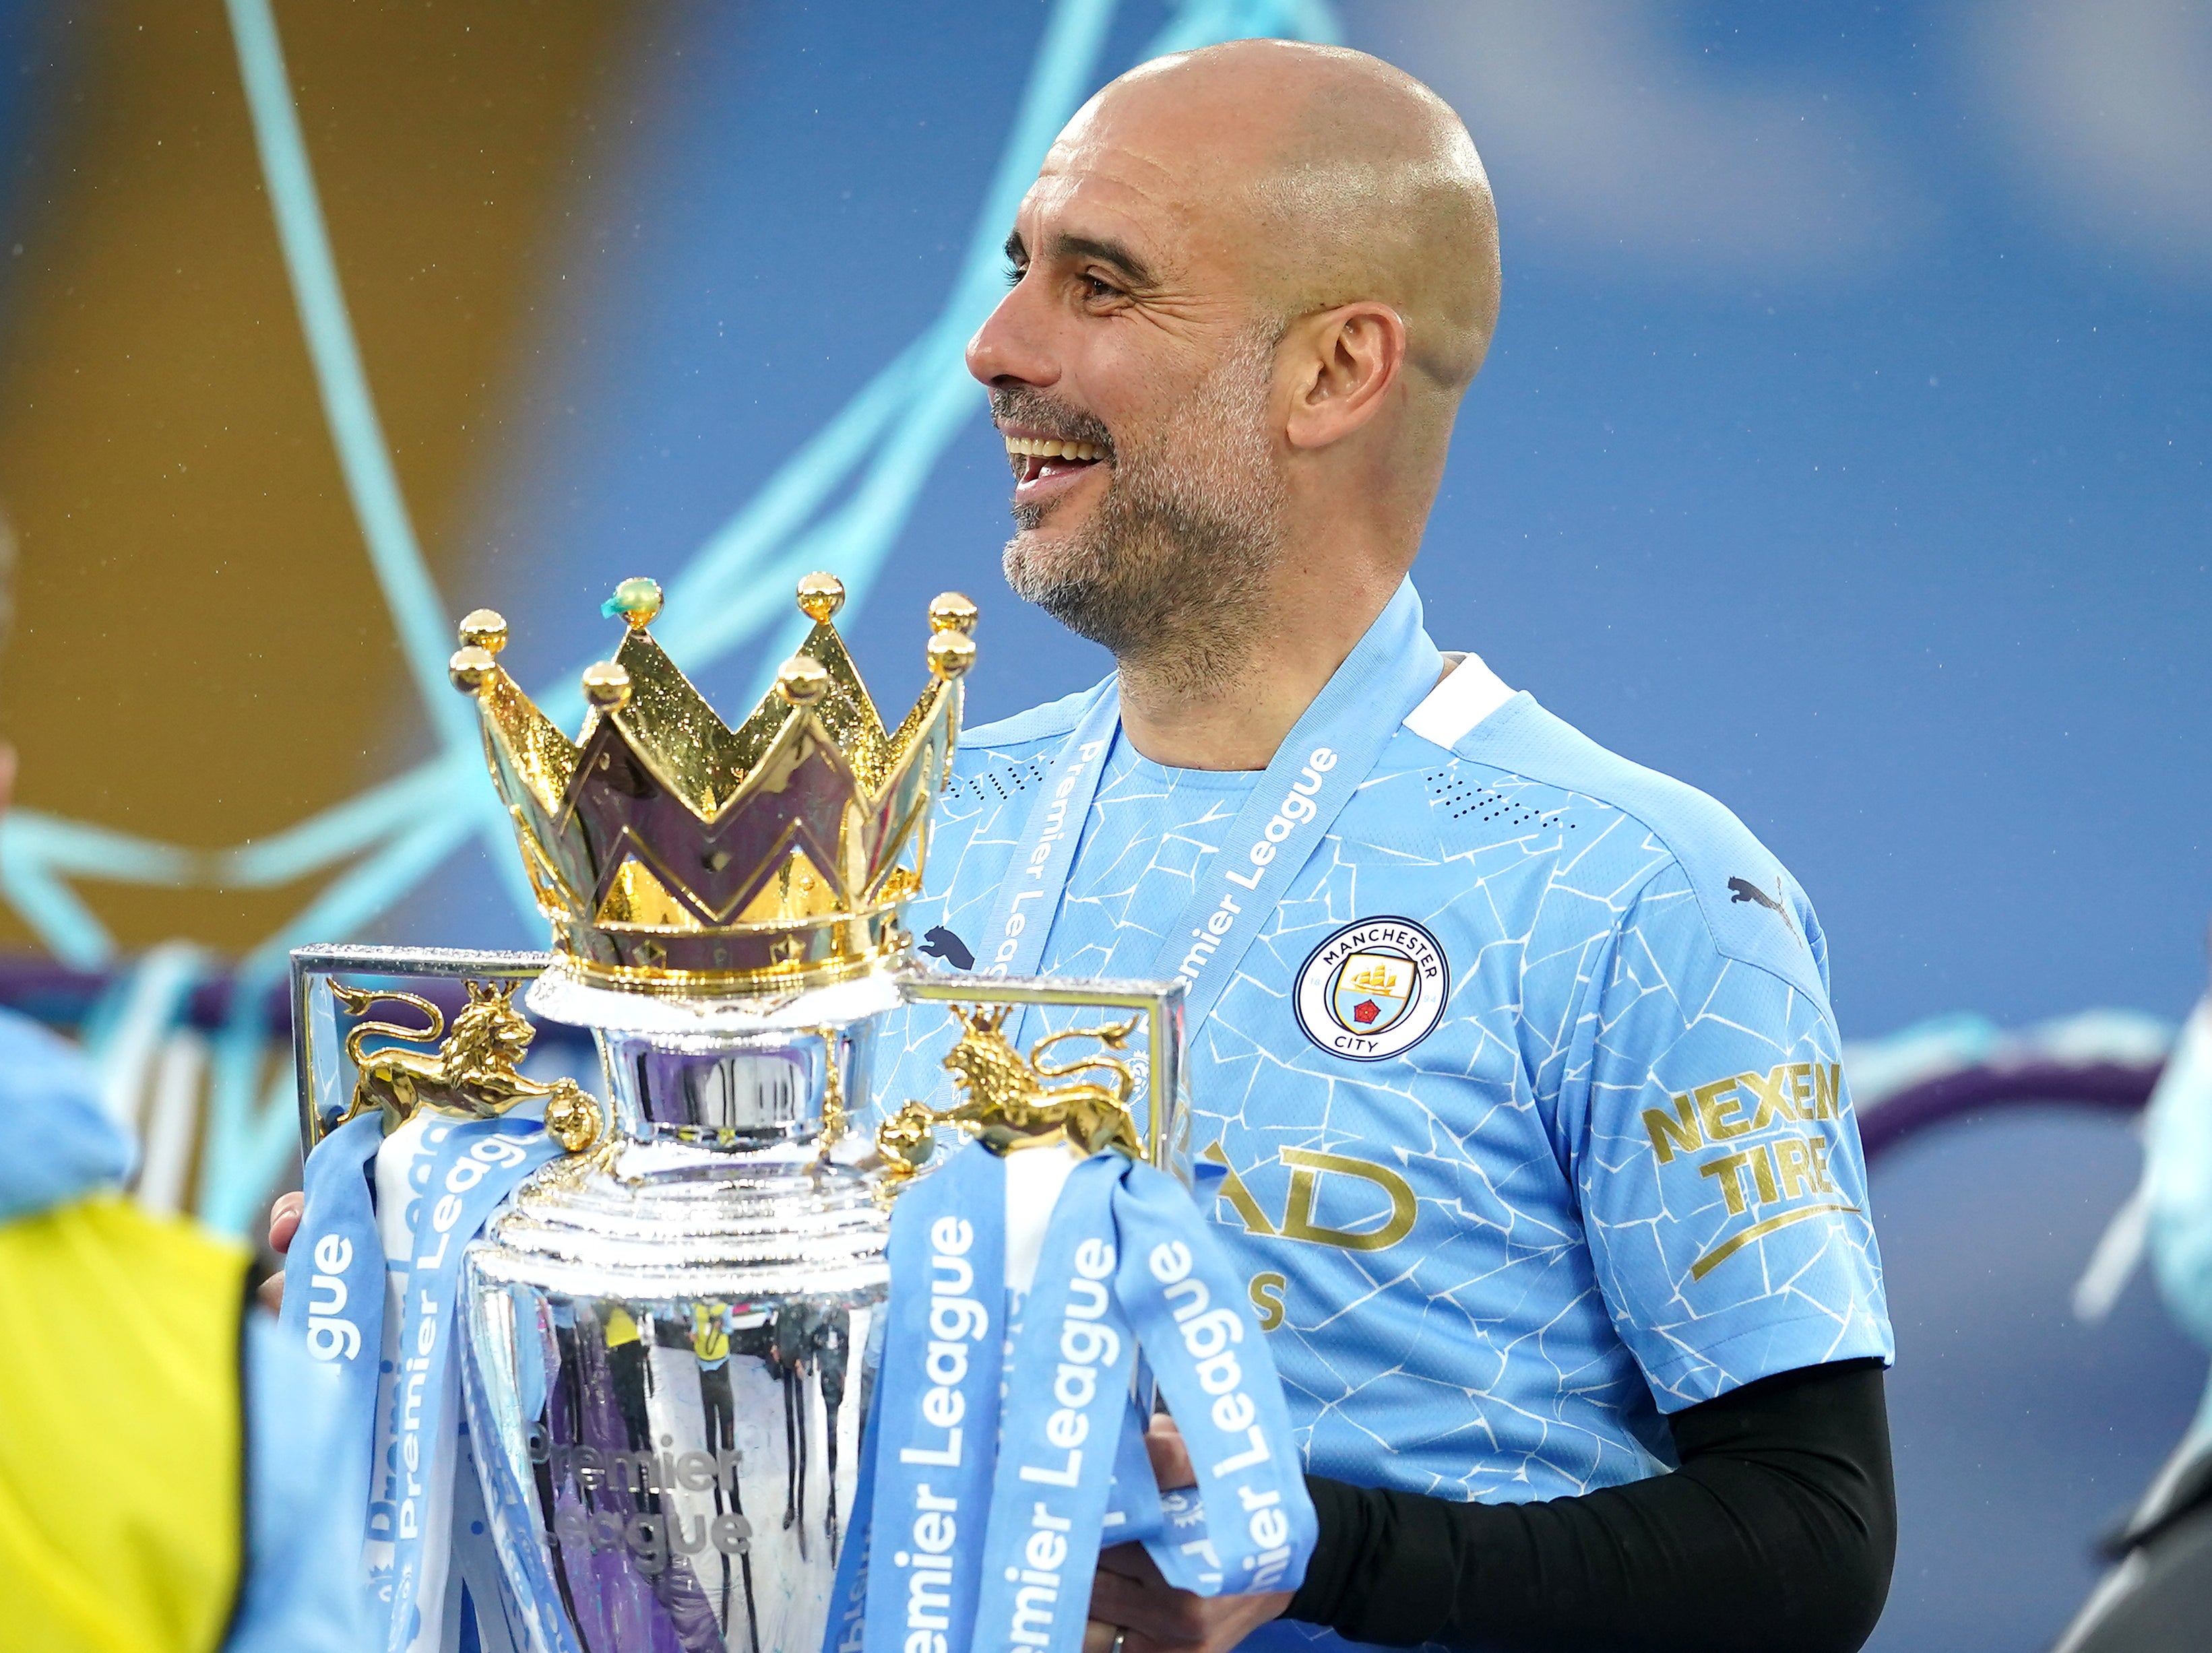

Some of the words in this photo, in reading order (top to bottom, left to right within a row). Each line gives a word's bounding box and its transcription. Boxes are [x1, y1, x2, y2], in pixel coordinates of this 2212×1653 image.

[1026, 739, 1105, 880] Premier
[1170, 893, 1242, 998] emier
[1225, 746, 1337, 890] League
[982, 889, 1045, 977] Leag
[1309, 977, 1321, 987] 18
[1323, 928, 1437, 979] MANCHESTER
[1334, 1035, 1379, 1053] CITY
[1423, 994, 1436, 1004] 94
[1641, 1062, 1841, 1165] NEXEN
[1699, 1136, 1834, 1217] TIRE
[307, 1233, 362, 1362] gue
[900, 1215, 988, 1468] League
[400, 1289, 439, 1540] Premier
[1019, 1237, 1120, 1487] League
[1149, 1239, 1271, 1479] League
[546, 1512, 753, 1576] eague
[894, 1483, 957, 1653] emier
